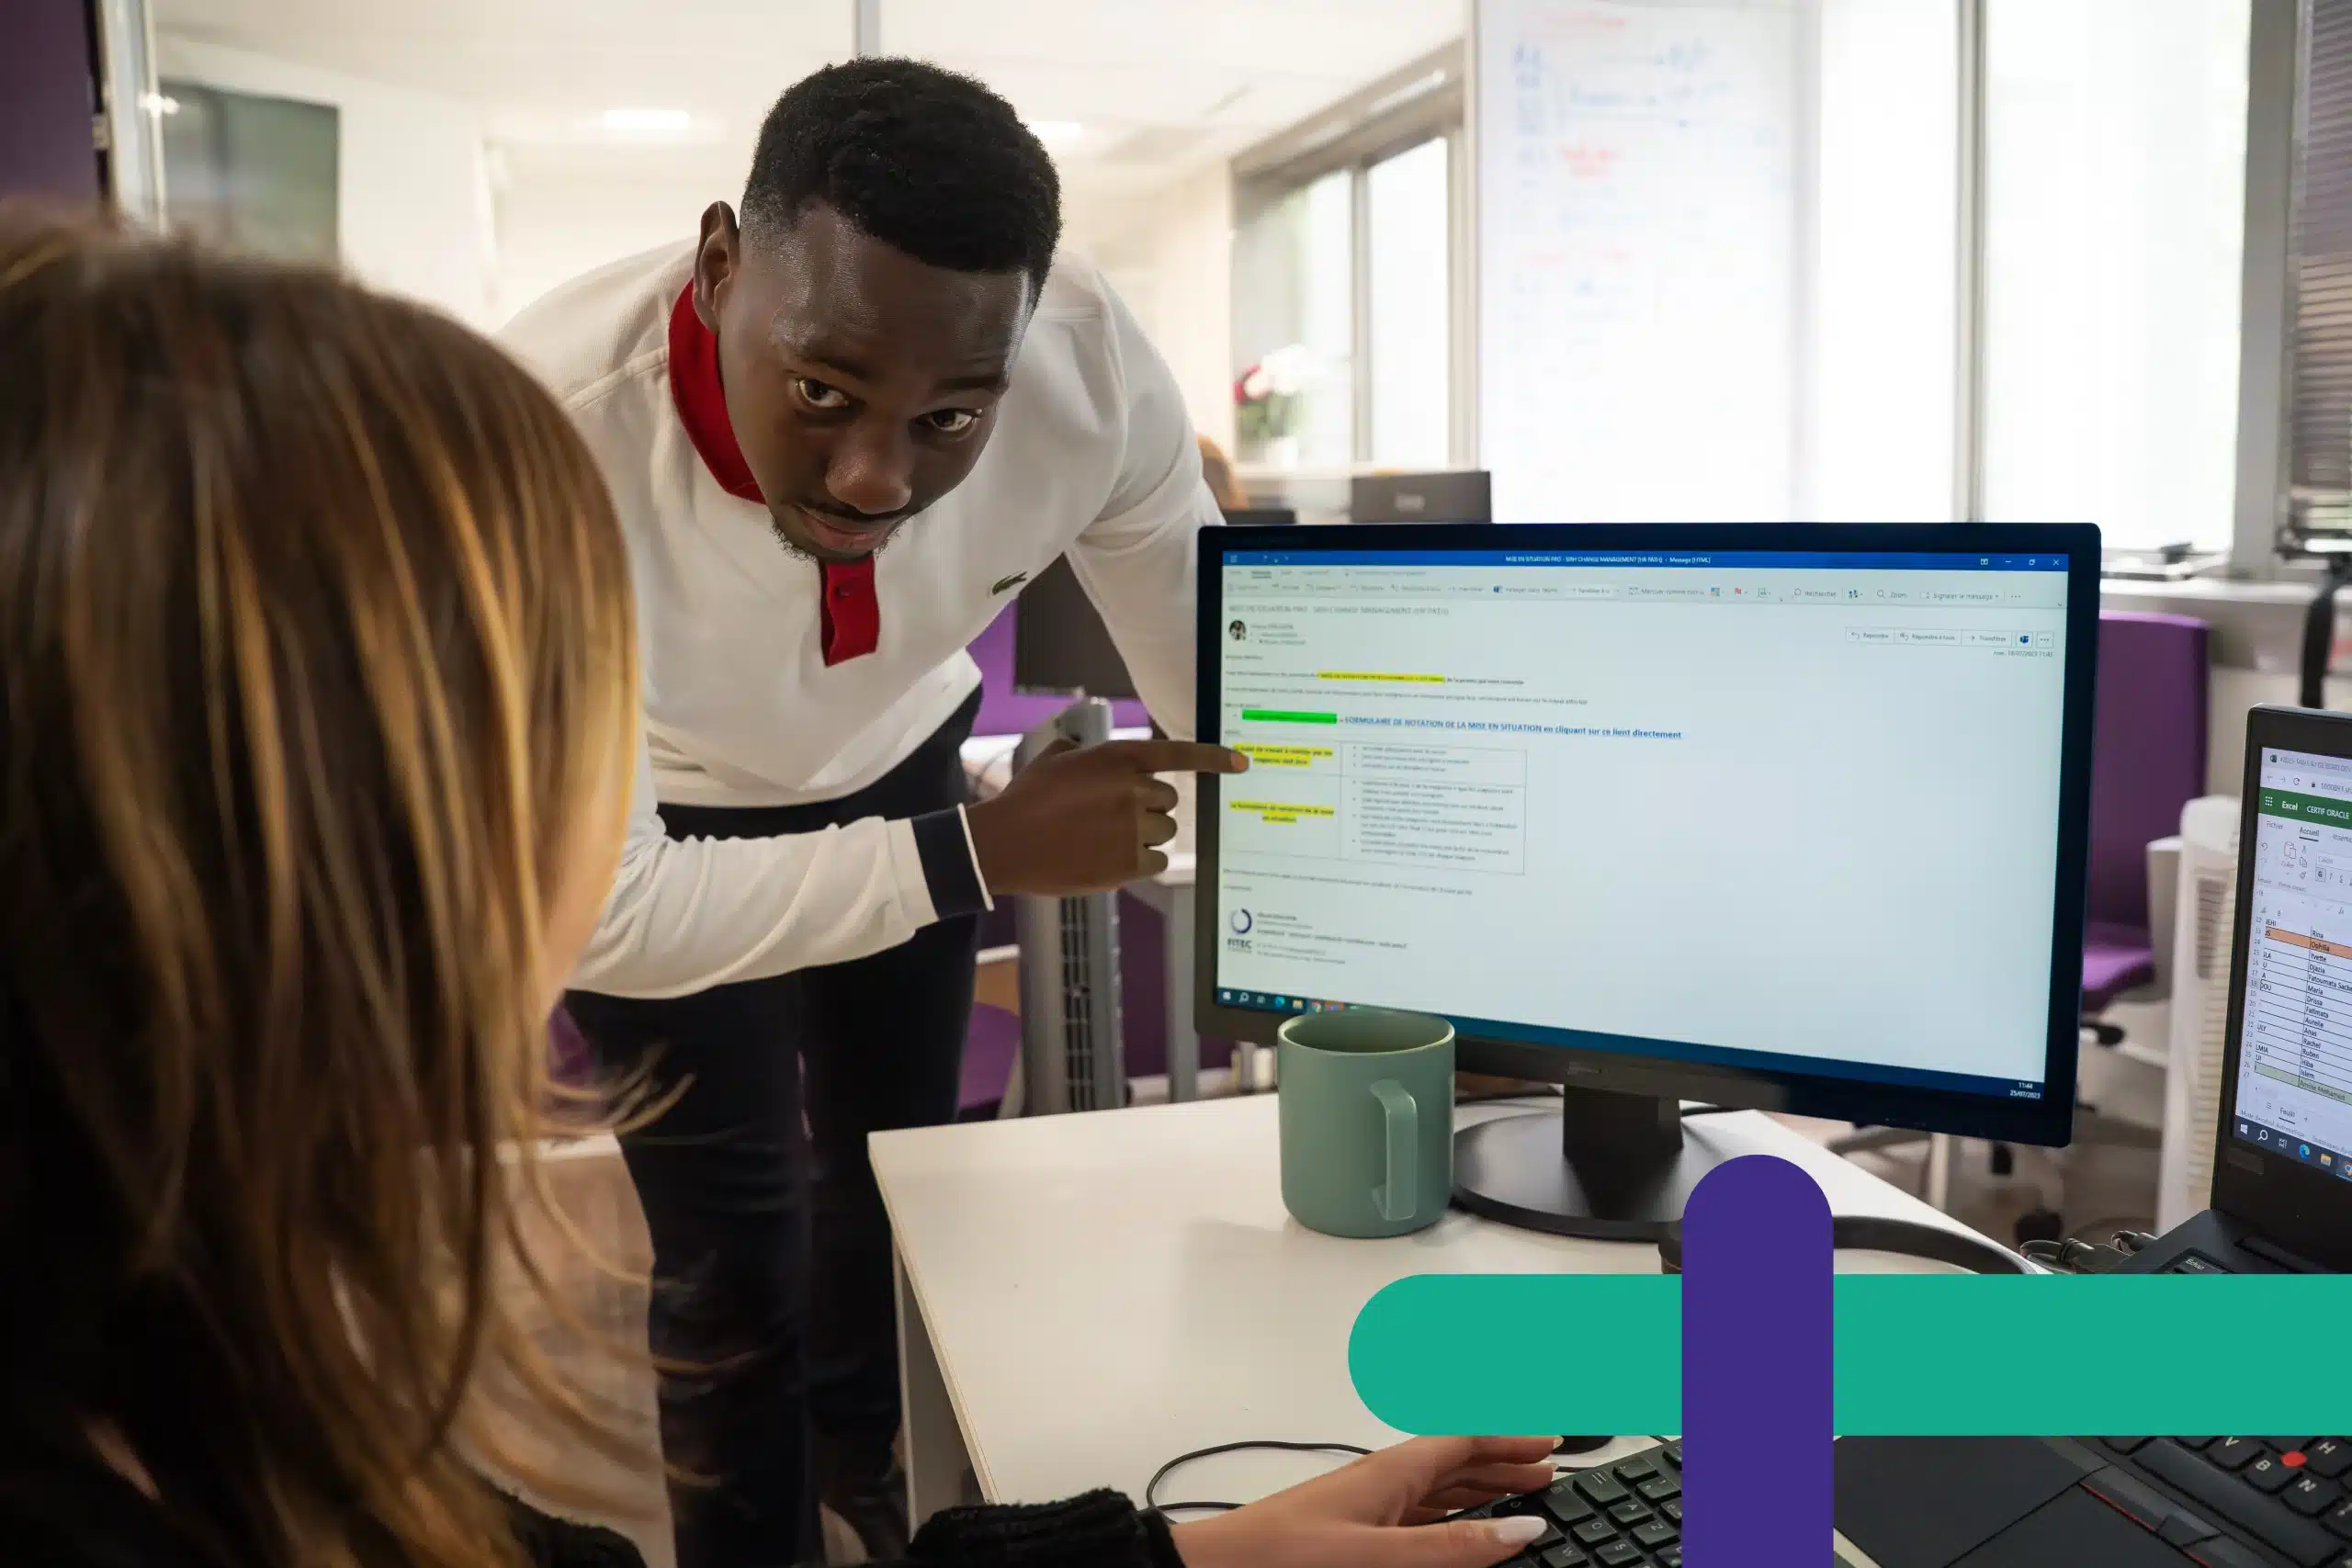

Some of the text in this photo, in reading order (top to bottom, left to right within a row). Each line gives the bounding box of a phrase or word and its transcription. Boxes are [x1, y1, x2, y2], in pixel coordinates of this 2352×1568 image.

[1669, 557, 1691, 565] Message
[1890, 591, 1907, 599] Zoom
[1933, 592, 1957, 602] Signaler
[1966, 593, 1994, 602] message
[1345, 716, 1391, 726] FORMULAIRE
[1393, 717, 1402, 726] DE
[1405, 718, 1443, 728] NOTATION
[1445, 720, 1455, 728] DE
[1457, 721, 1466, 729] LA
[1467, 722, 1487, 730] MISE
[1488, 723, 1498, 731] EN
[1498, 723, 1542, 733] SITUATION
[1555, 725, 1587, 736] cliquant
[1633, 728, 1682, 739] directement
[2281, 800, 2350, 820] Excel CERTIF ORACLE
[2267, 820, 2284, 830] Fichier
[2299, 826, 2320, 837] Accueil
[2311, 952, 2327, 963] Yvette
[2309, 964, 2325, 974] Djazia
[2308, 974, 2337, 988] Fatoumata
[2307, 985, 2324, 995] Maria
[2307, 996, 2323, 1007] Drissa
[2306, 1006, 2329, 1019] Fatimata
[2303, 1038, 2322, 1049] Rachel
[2302, 1048, 2320, 1060] Ruben
[2301, 1059, 2314, 1069] Hiba
[2301, 1069, 2314, 1079] Islem
[2318, 1440, 2337, 1455] H
[2255, 1459, 2272, 1472] B
[2297, 1478, 2317, 1493] N
